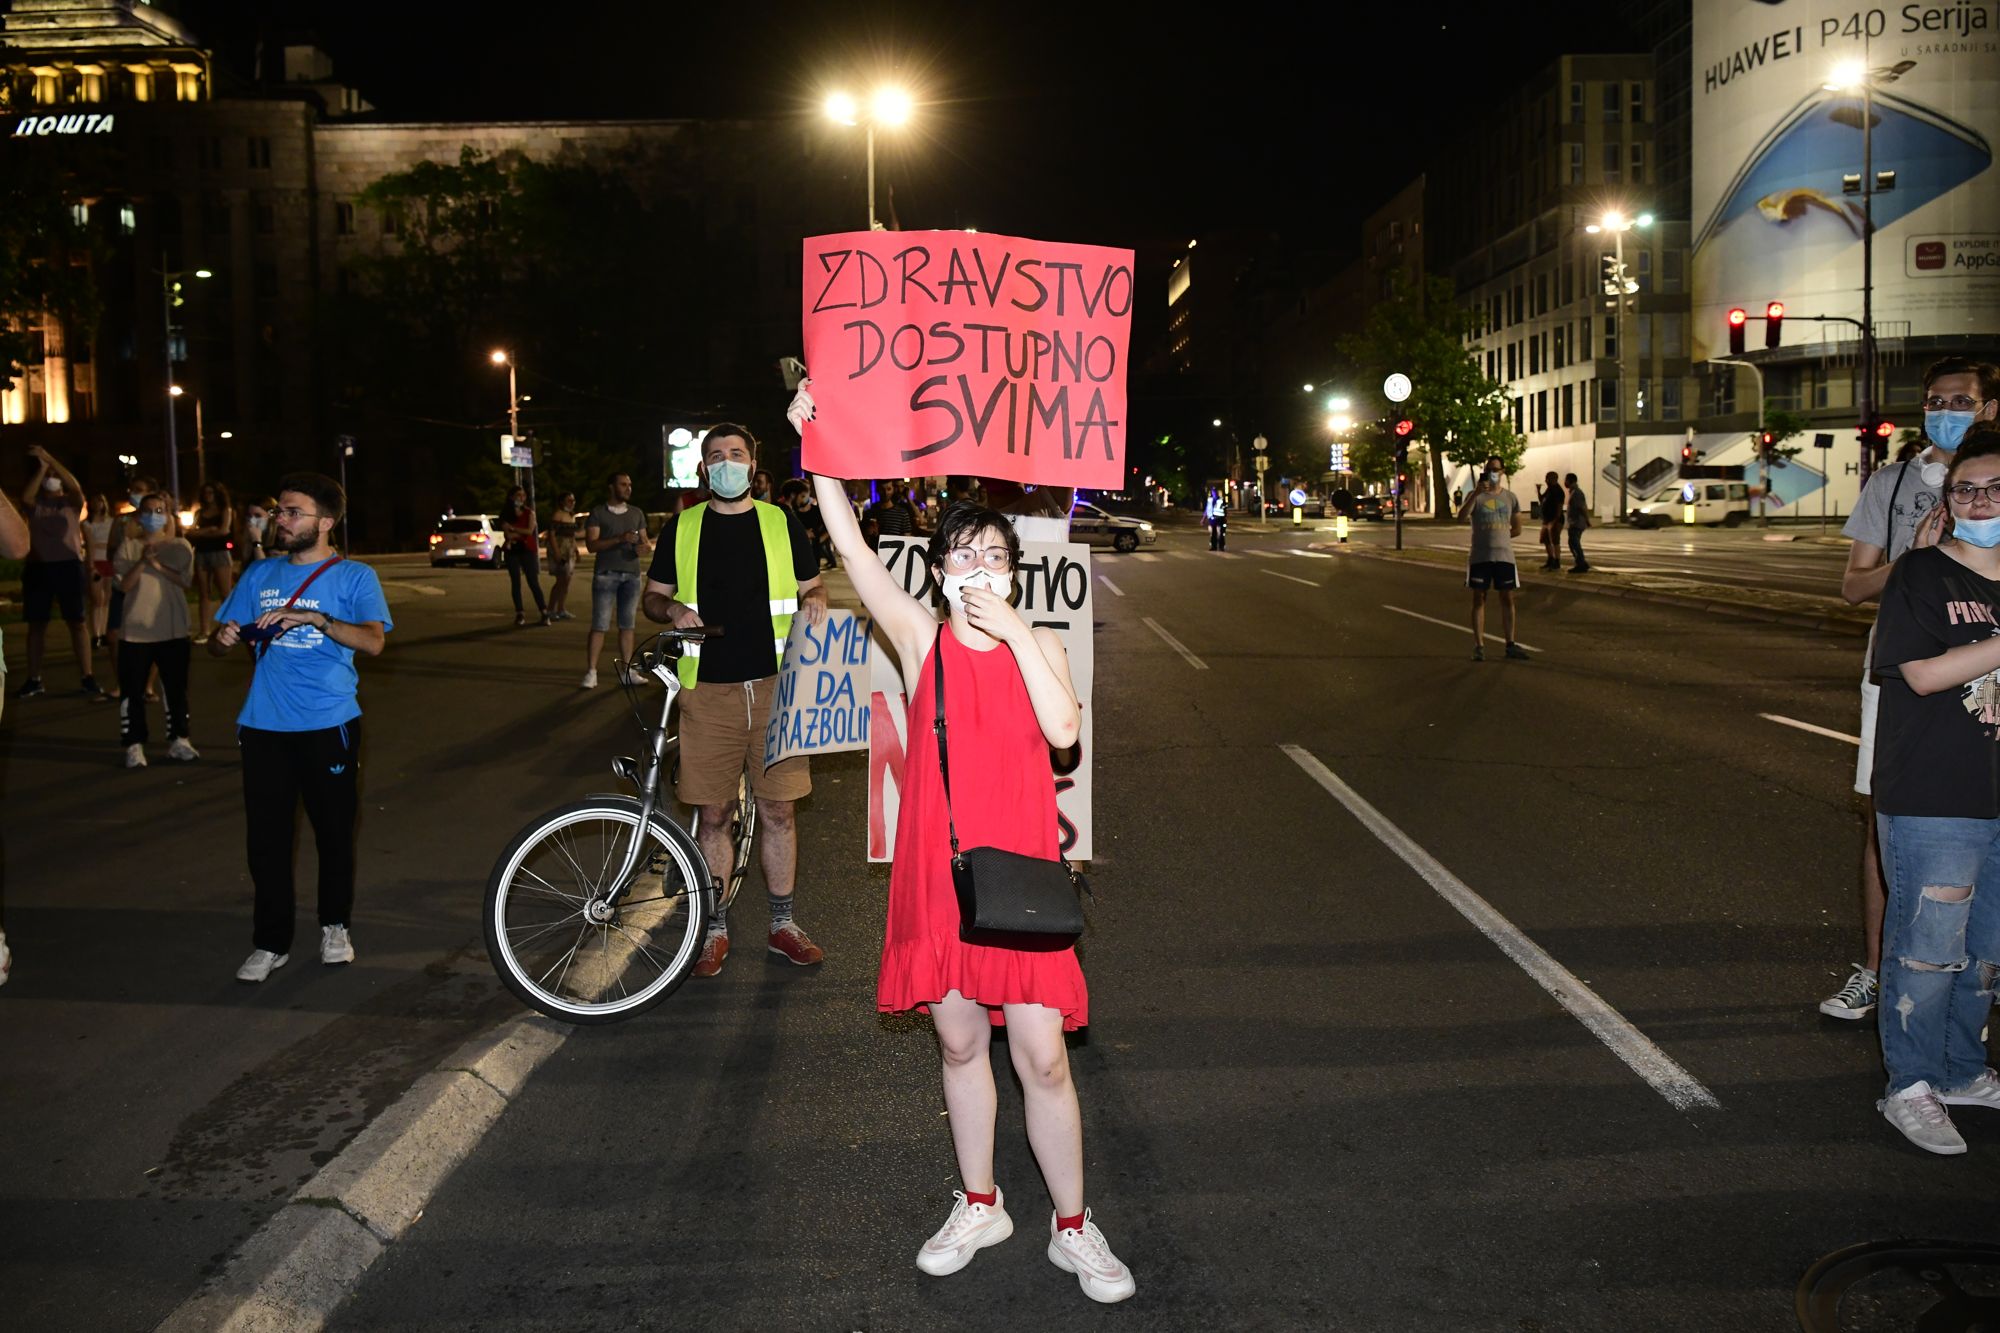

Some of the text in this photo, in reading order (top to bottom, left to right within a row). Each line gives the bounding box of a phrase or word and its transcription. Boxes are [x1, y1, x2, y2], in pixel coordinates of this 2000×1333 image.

[1705, 26, 1802, 94] HUAWEI
[1821, 9, 1885, 47] P40
[1901, 0, 1987, 37] Serija
[1917, 43, 1979, 55] SARADNJI
[15, 114, 115, 136] ПОШТА
[812, 246, 1133, 318] ZDRAVSTVO
[844, 319, 1116, 383] DOSTUPNO
[901, 373, 1119, 463] SVIMA
[776, 670, 856, 712] NI DA
